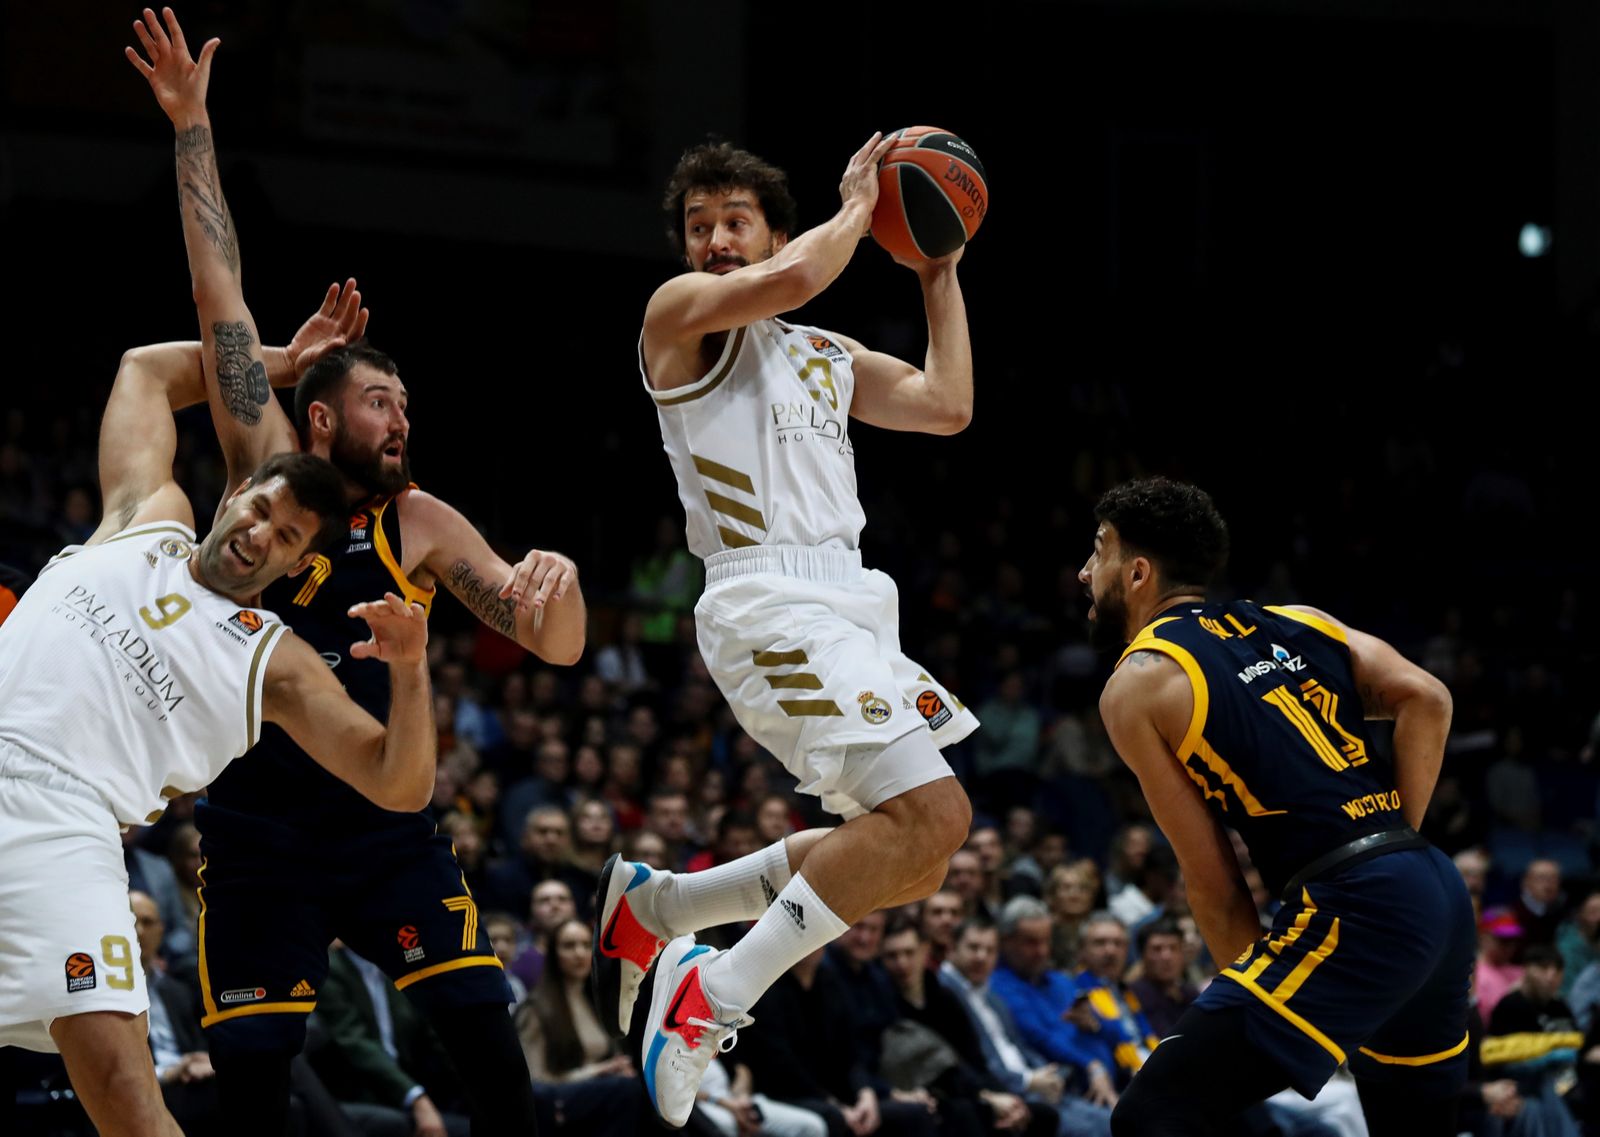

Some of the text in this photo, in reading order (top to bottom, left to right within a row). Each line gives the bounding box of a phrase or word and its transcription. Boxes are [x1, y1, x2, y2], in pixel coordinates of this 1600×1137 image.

[138, 592, 192, 631] 9
[442, 895, 478, 951] 7
[780, 899, 806, 930] adidas
[100, 935, 135, 992] 9
[224, 992, 254, 1001] Winline
[290, 989, 316, 997] adidas
